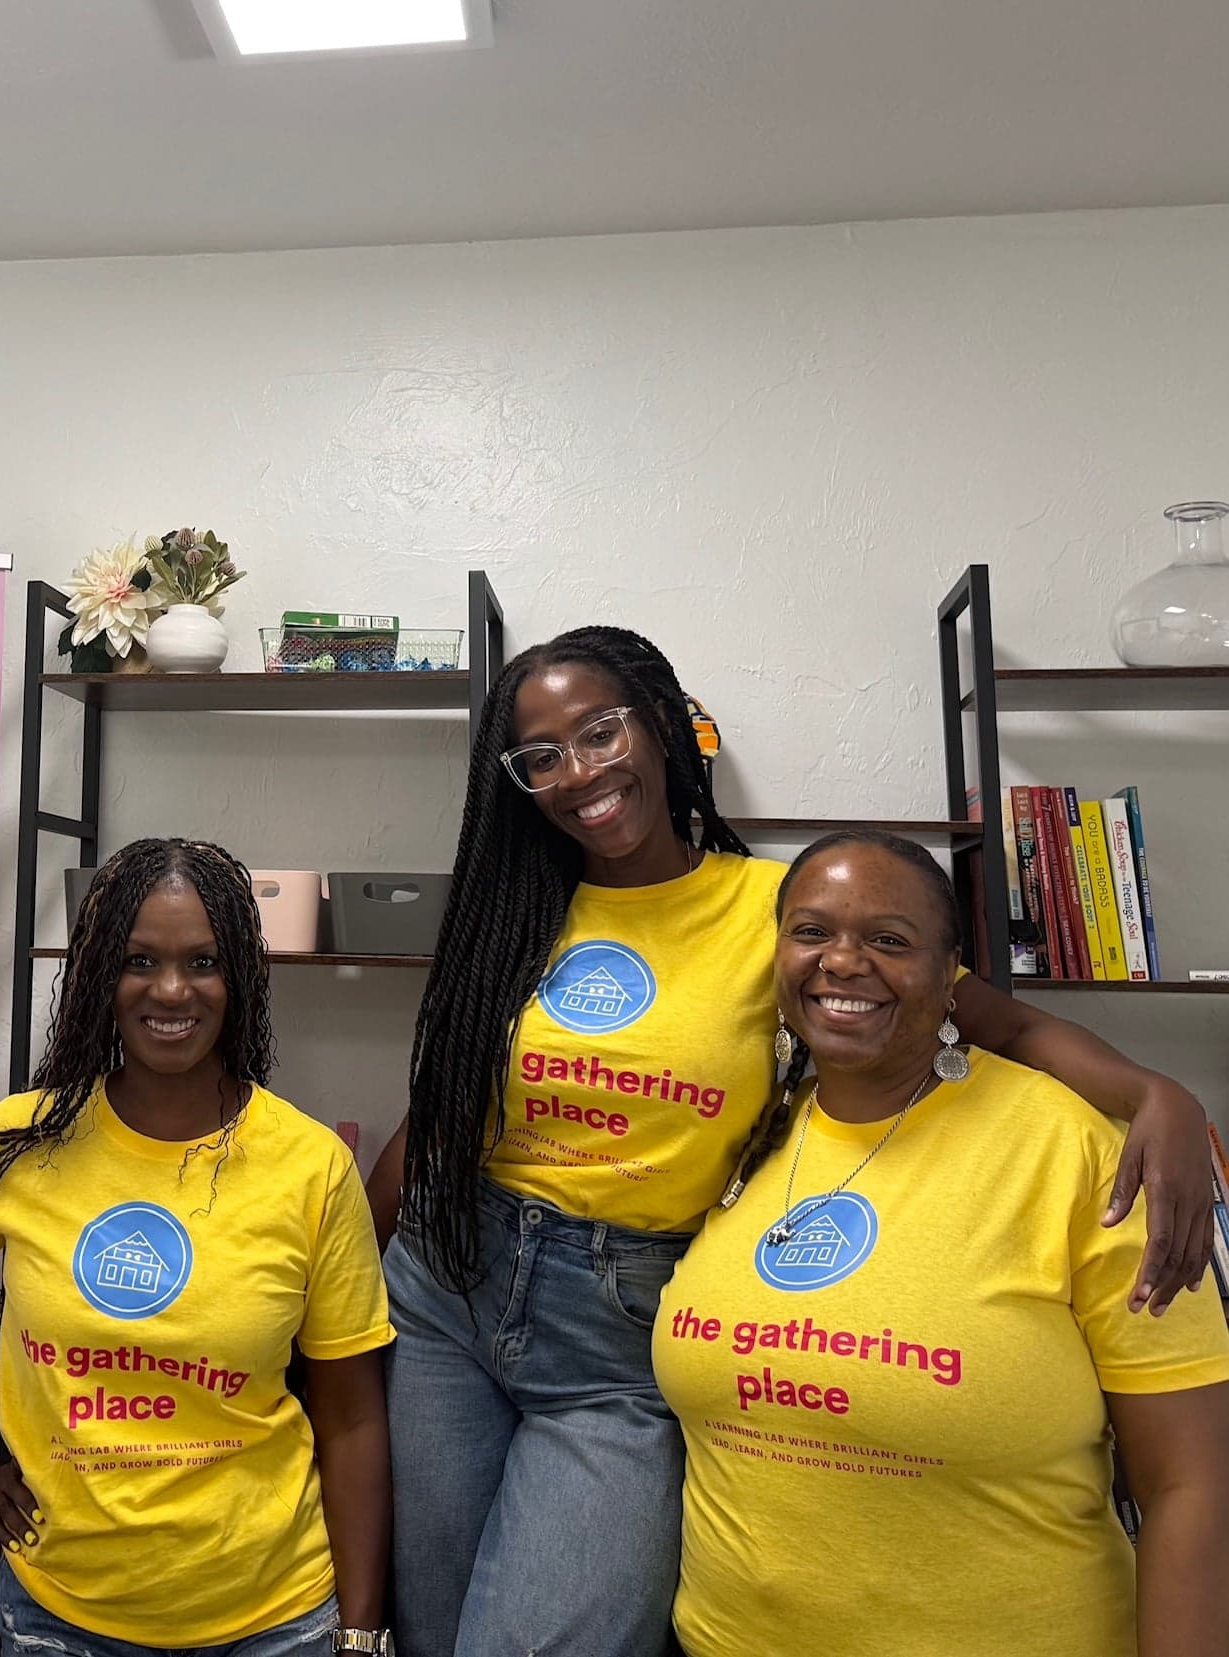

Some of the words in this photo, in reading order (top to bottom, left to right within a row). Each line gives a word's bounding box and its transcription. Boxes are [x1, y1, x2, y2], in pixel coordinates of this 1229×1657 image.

[1087, 815, 1097, 837] YOU
[1091, 840, 1100, 854] are
[1095, 856, 1101, 864] a
[1119, 849, 1130, 871] Soup
[1094, 867, 1109, 907] BADASS
[1122, 881, 1134, 920] Teenage
[1127, 920, 1138, 940] Soul
[520, 1051, 726, 1119] gathering
[525, 1095, 629, 1137] place
[536, 1151, 556, 1164] AND
[558, 1143, 595, 1160] WHERE
[672, 1306, 722, 1341] the
[731, 1317, 962, 1386] gathering
[66, 1346, 251, 1398] gathering
[68, 1386, 176, 1430] place
[737, 1367, 850, 1415] place
[90, 1446, 110, 1455] LAB
[113, 1443, 152, 1454] WHERE
[156, 1440, 210, 1451] BRILLIANT
[213, 1439, 243, 1448] GIRLS
[712, 1421, 761, 1440] LEARNING
[764, 1432, 785, 1444] LAB
[788, 1436, 829, 1451] WHERE
[832, 1442, 899, 1460] BRILLIANT
[903, 1454, 944, 1466] GIRLS
[734, 1443, 768, 1460] LEARN,
[771, 1451, 793, 1463] AND
[797, 1456, 830, 1469] GROW
[835, 1461, 865, 1473] BOLD
[869, 1465, 922, 1478] FUTURES
[93, 1462, 116, 1471] AND
[119, 1460, 152, 1469] GROW
[156, 1458, 183, 1467] BOLD
